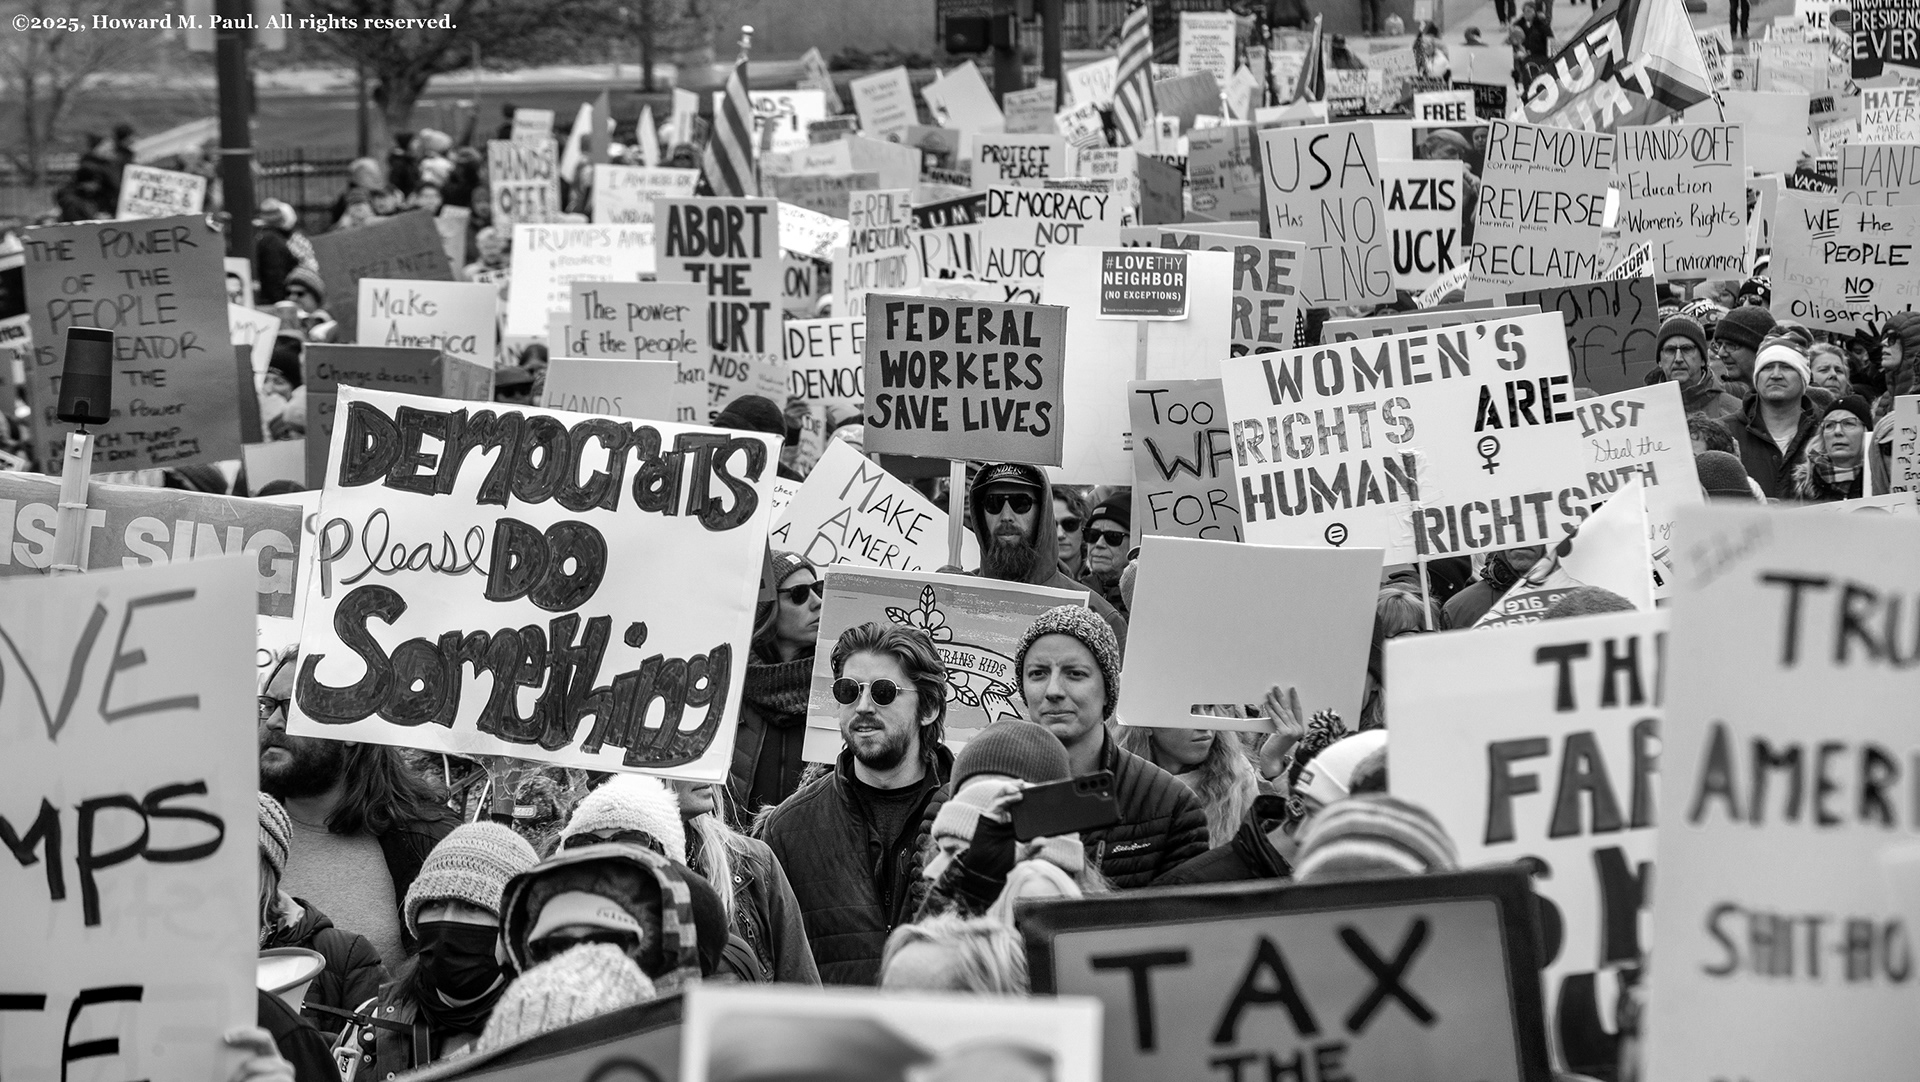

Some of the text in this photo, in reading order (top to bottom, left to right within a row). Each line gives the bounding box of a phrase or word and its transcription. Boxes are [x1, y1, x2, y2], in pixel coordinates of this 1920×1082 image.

[1852, 29, 1918, 59] EVER
[1423, 103, 1467, 122] FREE
[1864, 89, 1917, 110] HATE
[1865, 108, 1916, 125] NEVER
[981, 144, 1051, 164] PROTECT
[1265, 131, 1375, 193] USA
[1488, 122, 1613, 170] REMOVE
[1000, 163, 1049, 180] PEACE
[1628, 171, 1712, 200] Education
[988, 188, 1109, 221] DEMOCRACY
[1381, 178, 1456, 212] AZIS
[1479, 185, 1605, 228] REVERSE
[664, 203, 768, 259] ABORT
[1036, 221, 1085, 248] NOT
[1320, 196, 1376, 244] NO
[1627, 201, 1741, 238] Women's Rights
[1804, 208, 1894, 232] WE the
[25, 225, 199, 262] THE POWER
[1393, 228, 1457, 275] UCK
[1469, 242, 1598, 281] RECLAIM
[1662, 239, 1750, 274] Environment
[1824, 241, 1912, 266] PEOPLE
[117, 267, 172, 290] THE
[683, 263, 752, 296] THE
[1103, 272, 1184, 288] NEIGHBOR
[1300, 244, 1392, 306] ING
[1845, 276, 1875, 295] NO
[47, 292, 178, 335] PEOPLE
[370, 287, 438, 319] Make
[580, 288, 691, 333] The power
[1105, 290, 1182, 303] (NO EXCEPTIONS)
[384, 319, 478, 356] America
[709, 302, 771, 354] URT
[885, 301, 1042, 348] FEDERAL
[599, 329, 625, 354] the
[634, 328, 699, 364] people
[1262, 323, 1527, 406] WOMEN'S
[121, 368, 167, 388] THE
[676, 361, 706, 385] han
[709, 354, 750, 382] NDS
[879, 350, 1044, 391] WORKERS
[867, 393, 1053, 437] SAVE LIVES
[1232, 375, 1575, 467] RIGHTS ARE
[838, 459, 934, 546] MAKE
[1147, 488, 1240, 531] FOR
[1241, 455, 1589, 556] HUMAN RIGHTS
[817, 505, 922, 573] AMERI
[317, 507, 608, 612] Please DO
[0, 588, 201, 743] VE
[937, 647, 1008, 678] TRANS KIDS
[1533, 633, 1668, 713] TH
[1091, 915, 1440, 1053] TAX
